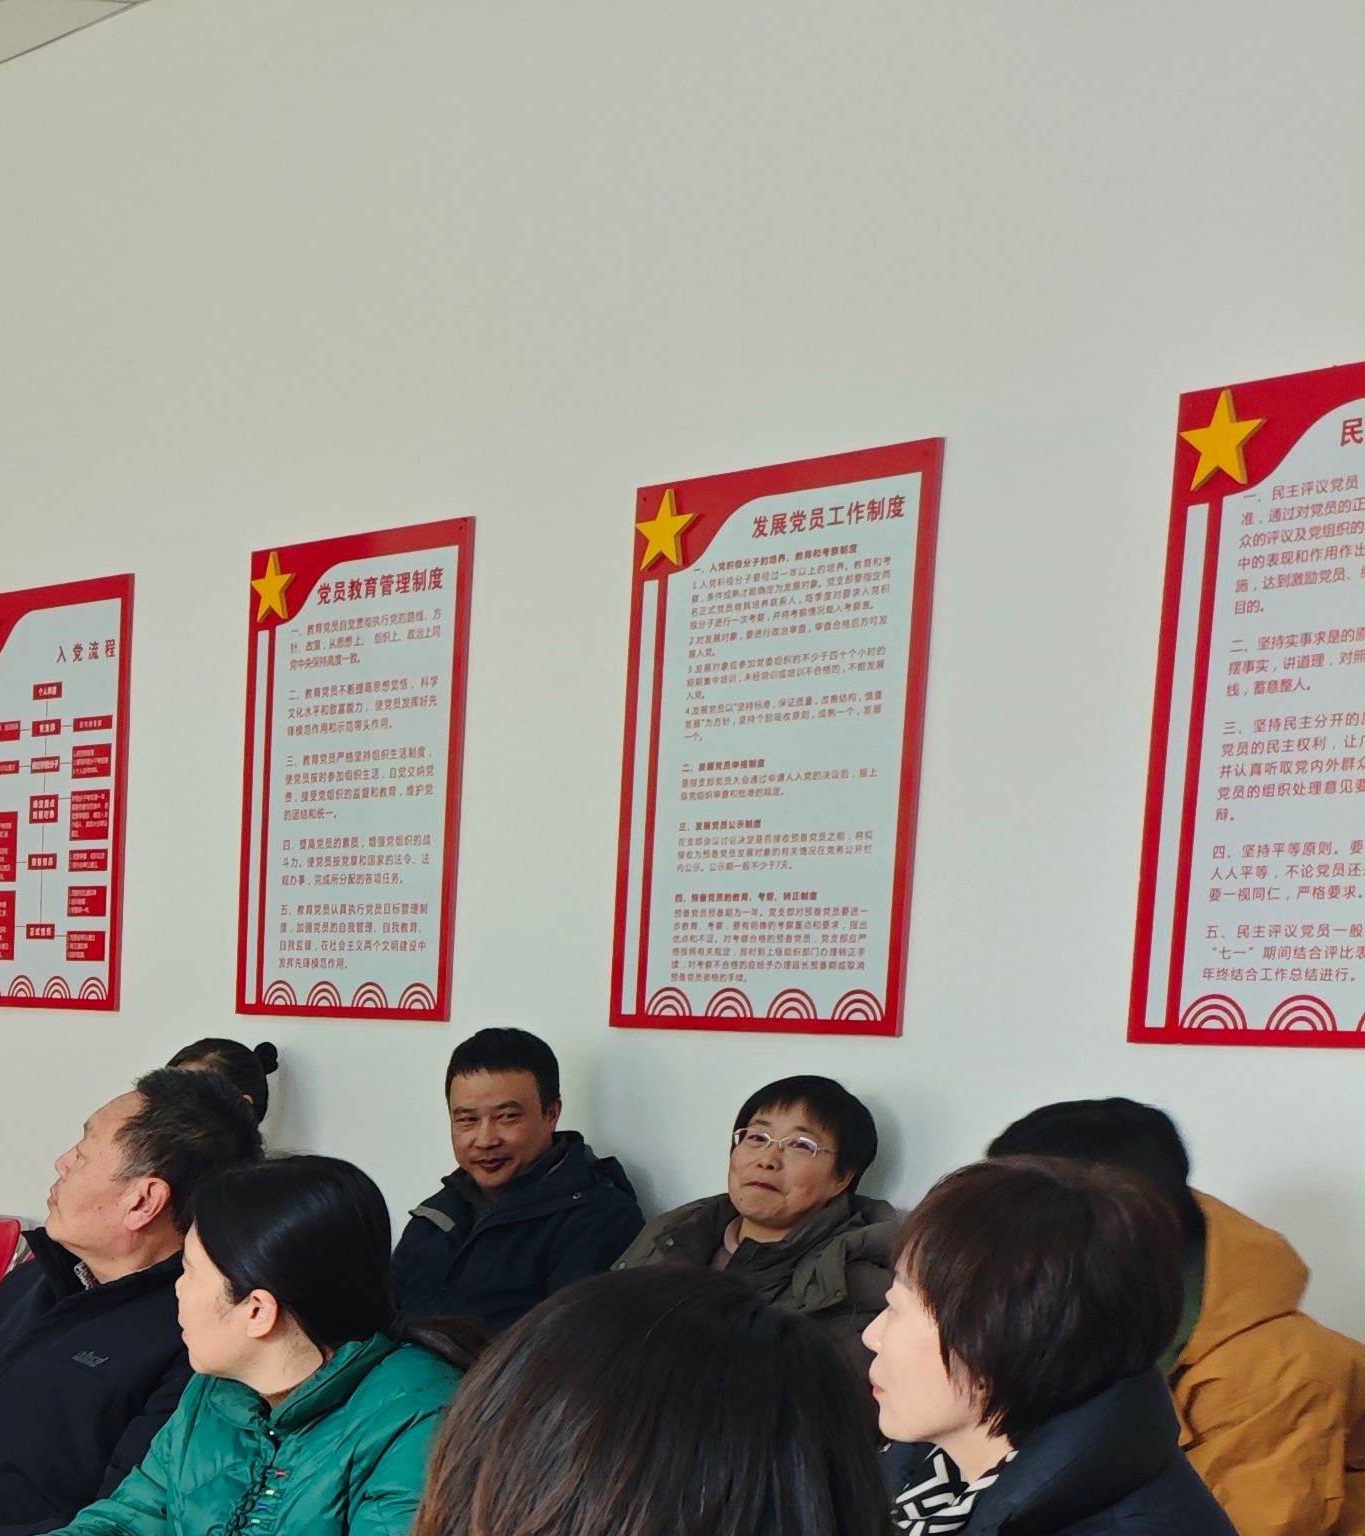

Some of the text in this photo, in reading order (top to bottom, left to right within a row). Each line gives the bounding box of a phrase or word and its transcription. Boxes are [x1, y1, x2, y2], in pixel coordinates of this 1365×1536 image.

[751, 495, 906, 539] 发展党员工作制度
[316, 567, 444, 606] 党员教育管理制度
[1234, 563, 1365, 594] 施，达到激励党员、
[1234, 597, 1264, 615] 目的。
[56, 639, 116, 663] 入党流程
[1209, 860, 1365, 881] 人人平等，不论党员还
